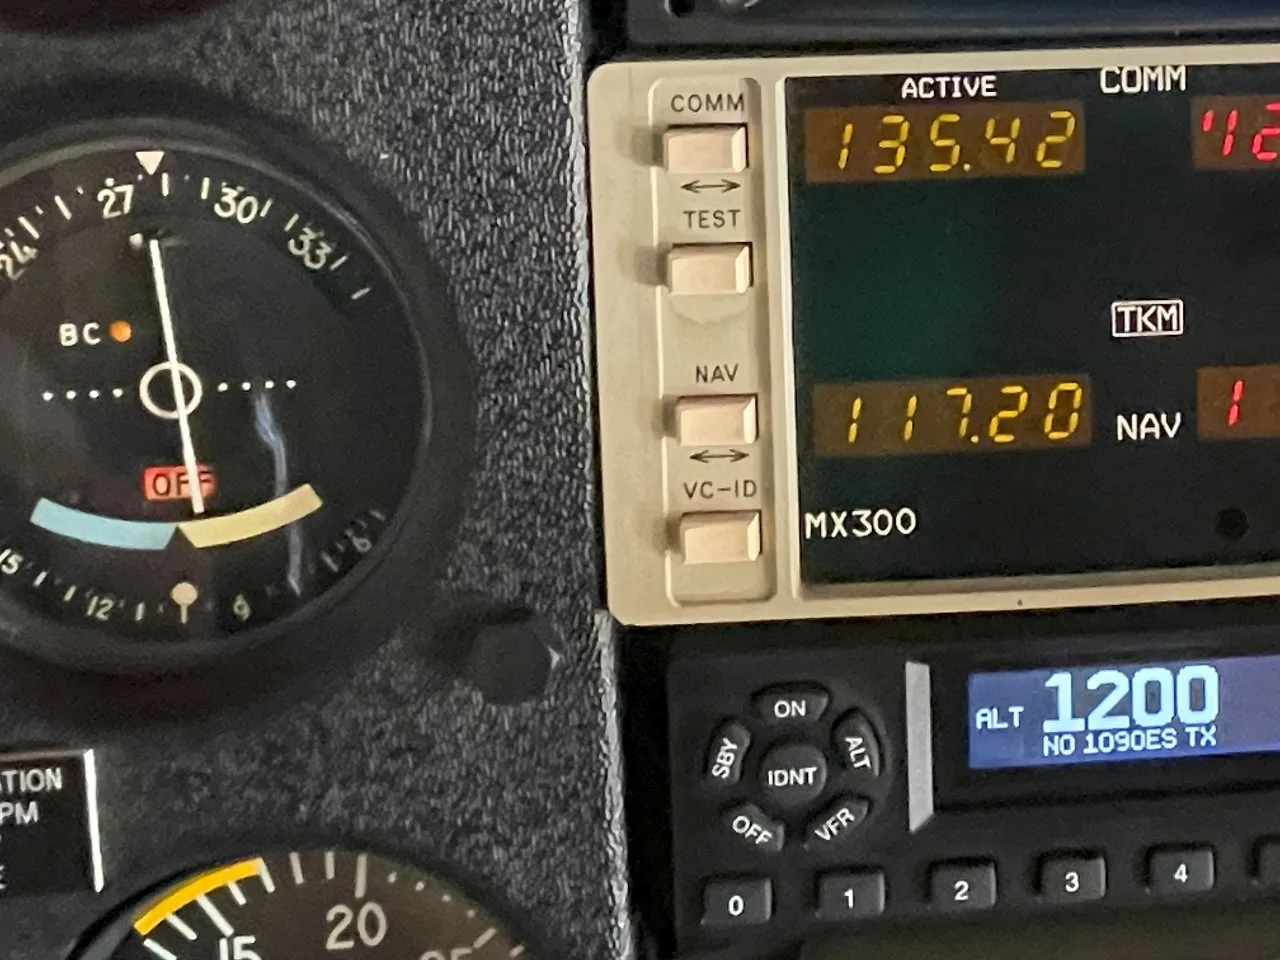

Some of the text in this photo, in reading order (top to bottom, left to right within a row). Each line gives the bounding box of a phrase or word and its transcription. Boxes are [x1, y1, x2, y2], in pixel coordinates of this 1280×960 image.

[901, 75, 998, 99] ACTIVE
[1100, 65, 1187, 93] COMM
[670, 93, 745, 114] COMM
[838, 111, 1076, 174] 135.42
[97, 183, 134, 219] 27
[214, 187, 259, 224] 30
[683, 209, 741, 229] TEST
[288, 226, 330, 271] 33
[1116, 304, 1179, 332] TKM
[59, 321, 100, 347] BC
[695, 364, 739, 384] NAV
[847, 382, 1084, 444] 117.20
[1116, 412, 1182, 441] NAV
[683, 479, 757, 501] VC-ID
[804, 508, 917, 540] MX300
[86, 595, 115, 621] 12
[774, 700, 807, 718] ON
[1042, 664, 1220, 734] 1200
[976, 705, 1025, 732] ALT
[845, 736, 872, 770] ALT
[1043, 725, 1218, 757] NO 1090ES TX
[712, 737, 738, 779] SBY
[0, 767, 63, 794] TION
[768, 767, 818, 787] IDNT
[732, 815, 773, 845] OFF
[815, 807, 855, 841] VFR
[1065, 872, 1080, 893] 3
[1173, 863, 1188, 883] 4
[844, 888, 854, 909] 1
[954, 880, 969, 901] 2
[728, 895, 744, 916] 0
[326, 901, 387, 951] 20
